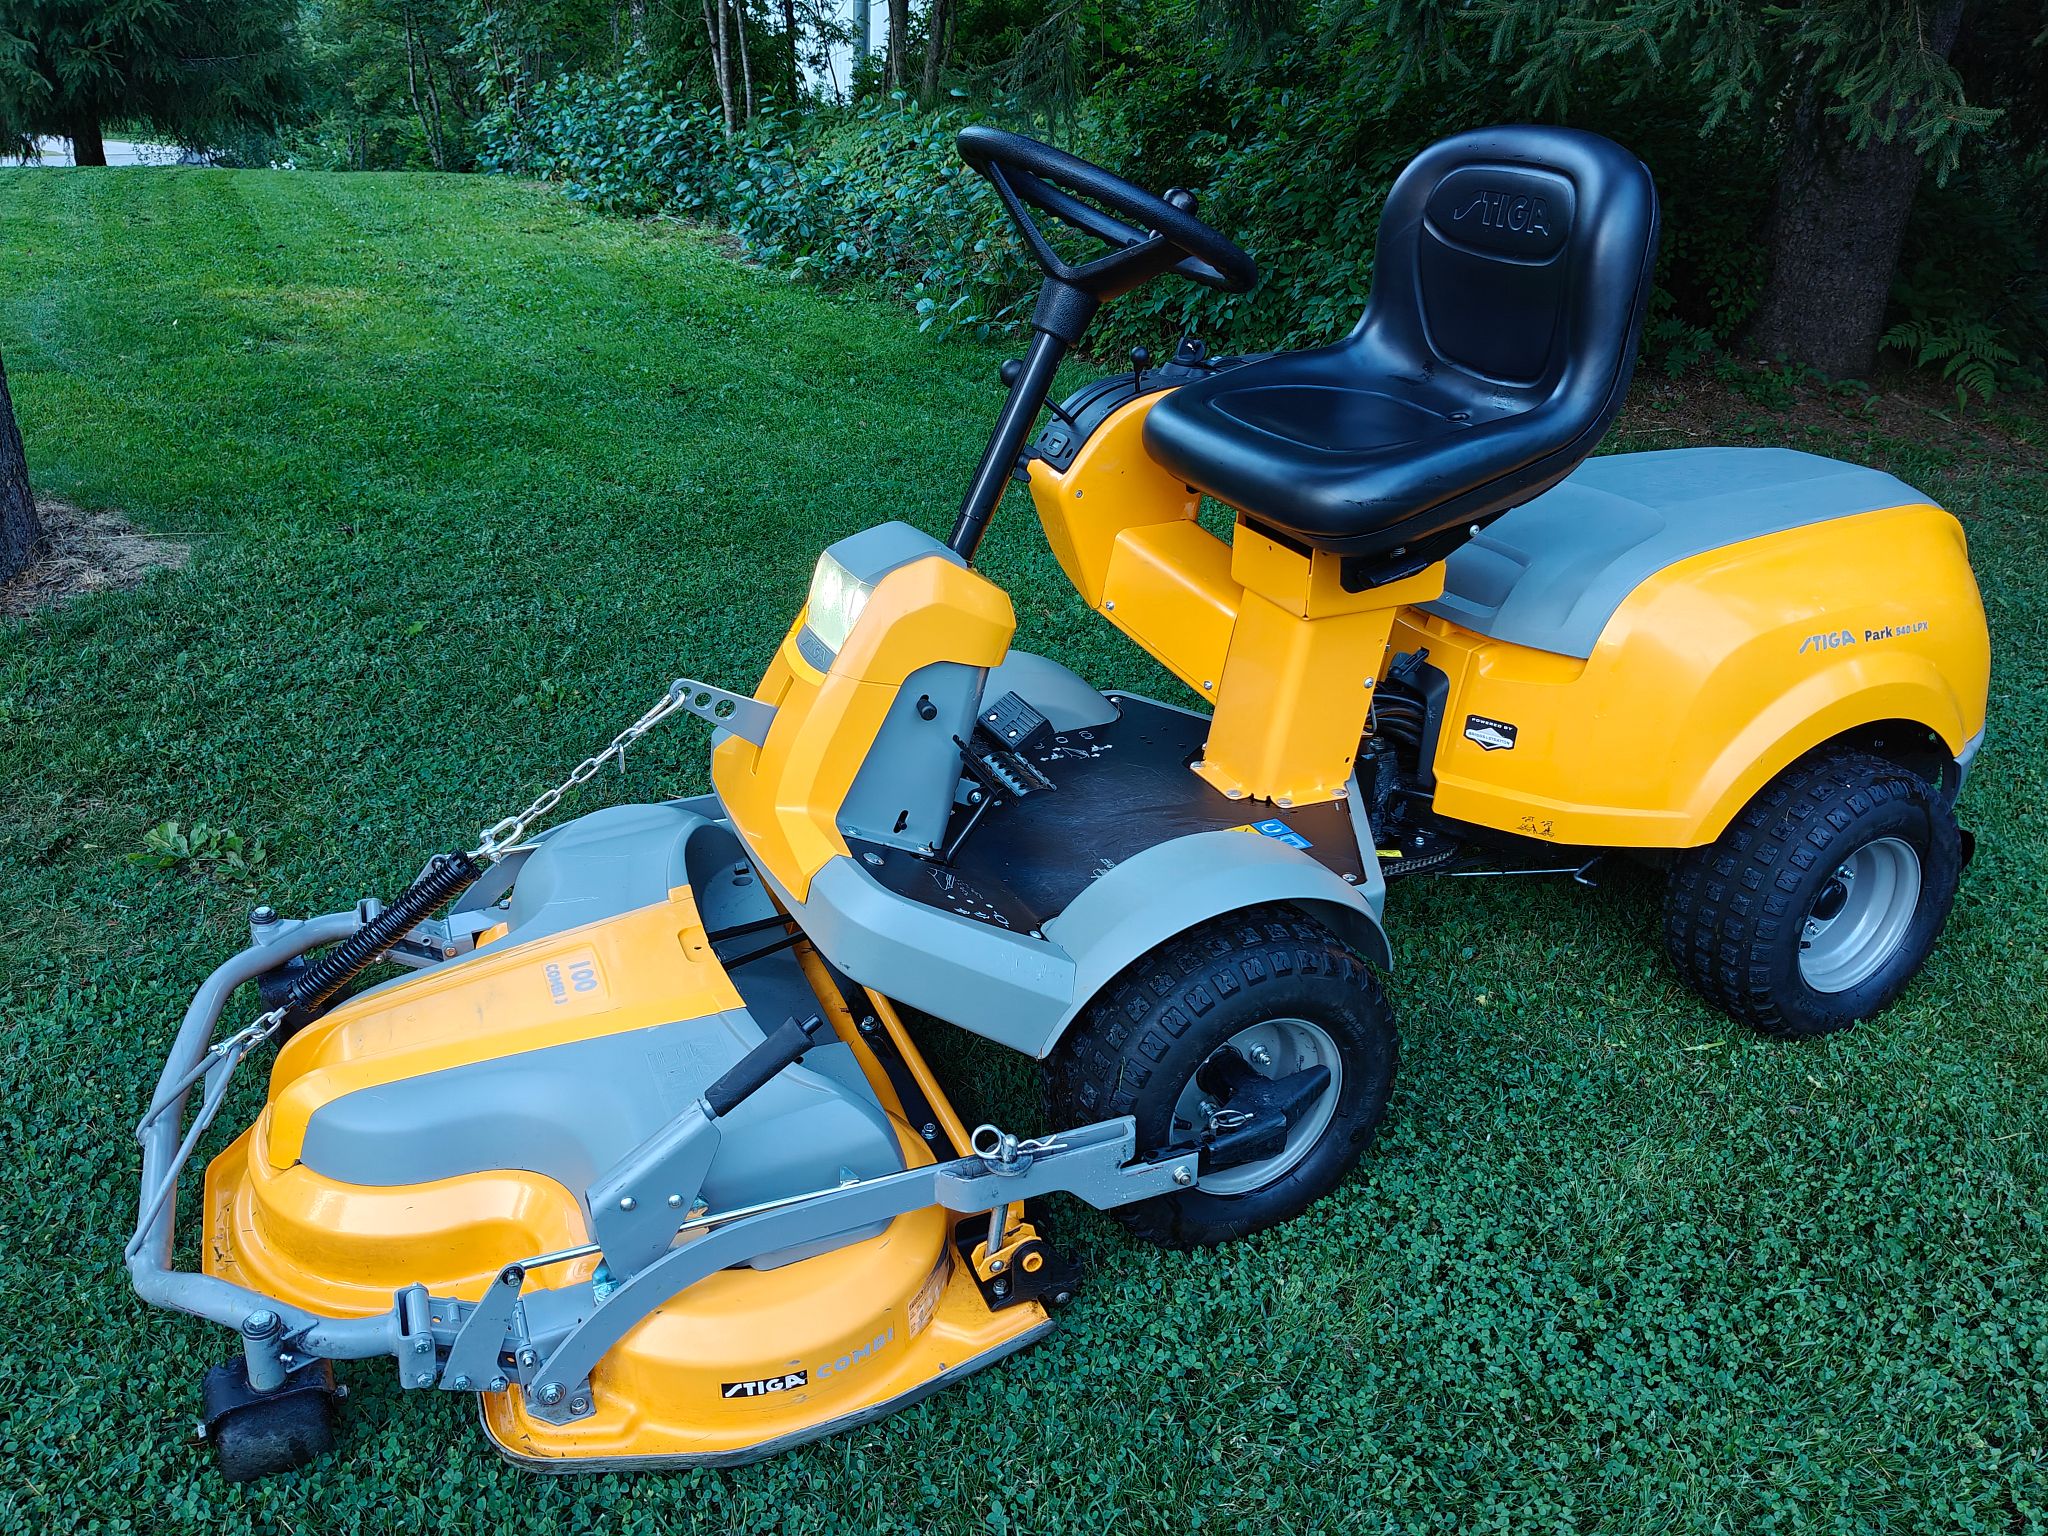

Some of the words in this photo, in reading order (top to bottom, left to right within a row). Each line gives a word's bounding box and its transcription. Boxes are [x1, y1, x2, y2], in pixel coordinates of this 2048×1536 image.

[1453, 190, 1551, 237] STIGA
[1799, 631, 1856, 654] STIGA
[1864, 626, 1893, 642] Park
[1896, 625, 1910, 636] 540
[1912, 621, 1928, 633] LPX
[1471, 717, 1502, 729] POWERED
[545, 963, 567, 997] COMBI
[724, 1373, 806, 1398] STIGA
[816, 1327, 893, 1379] COMBI
